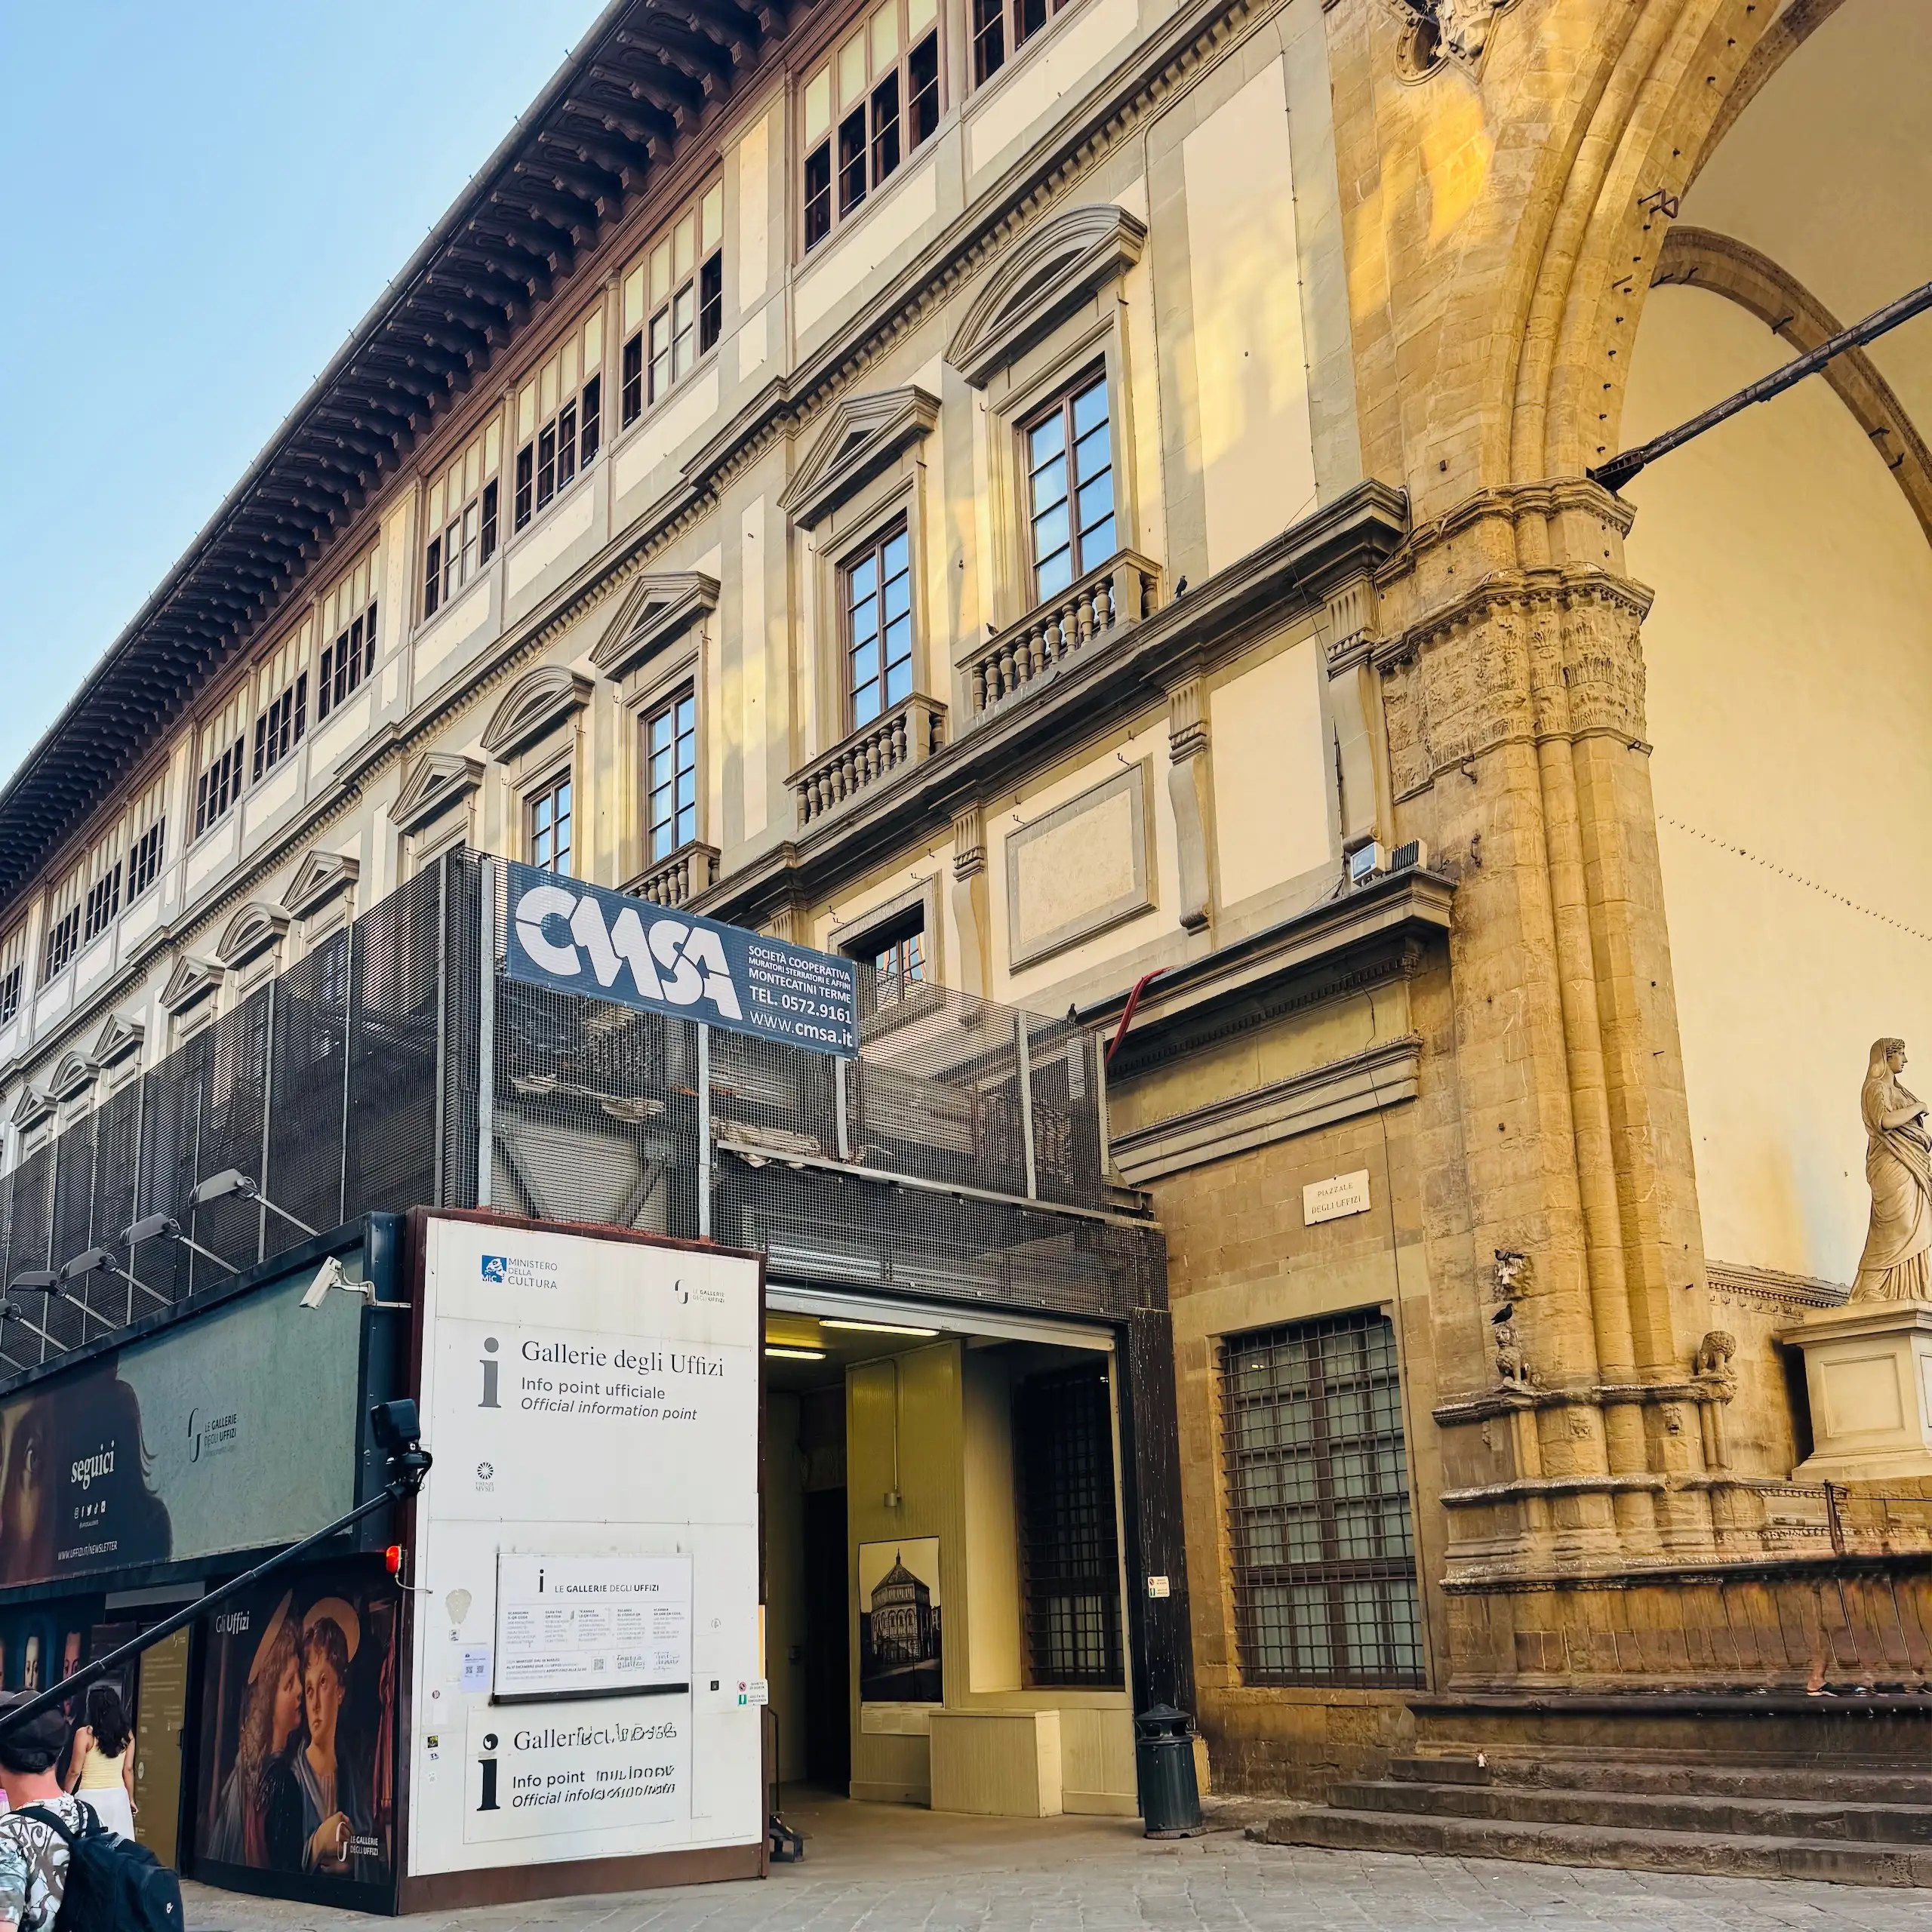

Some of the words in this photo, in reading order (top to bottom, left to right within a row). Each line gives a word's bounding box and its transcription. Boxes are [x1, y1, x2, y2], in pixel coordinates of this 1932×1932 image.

[515, 885, 743, 1021] CMSA
[748, 945, 786, 965] SOCIETÀ
[789, 957, 851, 982] COOPERATIVA
[748, 957, 785, 974] MURATORI
[786, 967, 824, 984] STERRATORI
[831, 980, 851, 992] AFFINI
[749, 968, 817, 995] MONTECATINI
[819, 986, 851, 1004] TERME
[749, 985, 778, 1006] TEL.
[782, 994, 852, 1025] 0572.9161
[750, 1011, 854, 1048] www.cmsa.it
[1317, 1182, 1353, 1198] PIAZZALE
[1312, 1202, 1334, 1214] DEGLI
[1336, 1195, 1361, 1208] UFFIZI
[508, 1258, 558, 1271] MINISTERO
[508, 1267, 532, 1276] DELLA
[508, 1276, 558, 1290] CULTURA
[521, 1340, 607, 1366] Gallerie
[614, 1349, 663, 1375] degli
[672, 1354, 724, 1377] Uffizi
[521, 1377, 552, 1392] Info
[559, 1382, 600, 1395] point
[606, 1385, 666, 1399] ufficiale
[521, 1398, 574, 1413] Official
[578, 1401, 659, 1418] information
[663, 1407, 697, 1420] point
[211, 1414, 237, 1430] GALLERIE
[220, 1427, 237, 1442] UFFIZI
[71, 1440, 115, 1490] seguici
[610, 1584, 632, 1592] DEGLI
[216, 1614, 226, 1632] Gli
[227, 1611, 249, 1635] Uffizi
[512, 1776, 542, 1789] Info
[547, 1771, 585, 1788] point
[512, 1791, 561, 1807] Official
[356, 1836, 378, 1846] GALLERIE
[363, 1847, 378, 1856] UFFIZI
